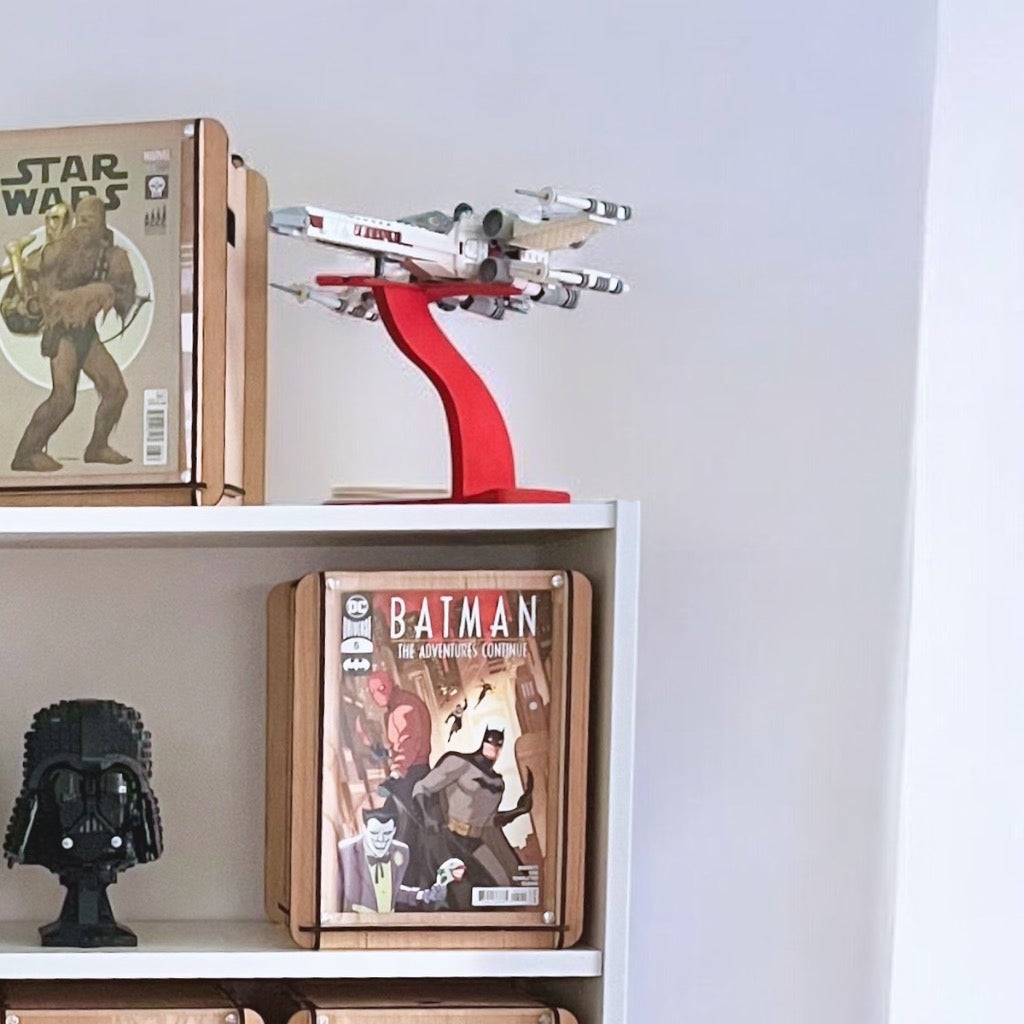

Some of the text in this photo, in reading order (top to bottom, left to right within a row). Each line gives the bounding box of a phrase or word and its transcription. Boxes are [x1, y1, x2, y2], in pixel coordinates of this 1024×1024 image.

[0, 153, 128, 186] STAR
[389, 595, 537, 639] BATMAN
[398, 642, 527, 659] THE ADVENTURES CONTINUE
